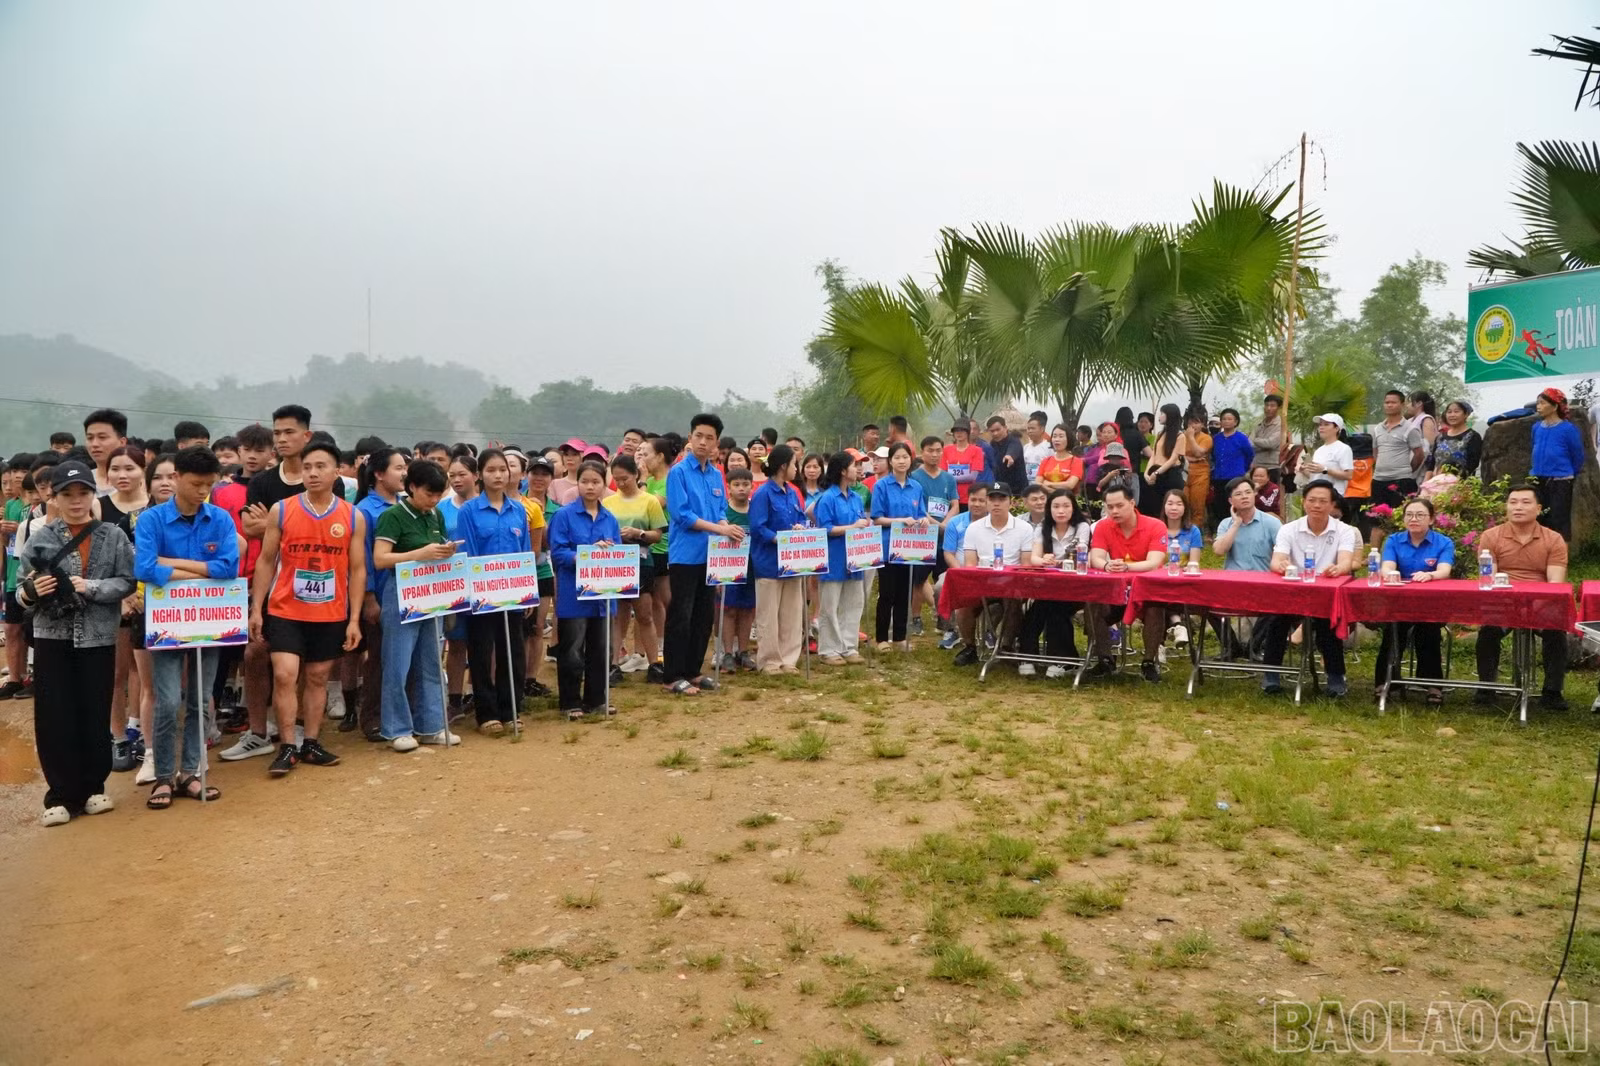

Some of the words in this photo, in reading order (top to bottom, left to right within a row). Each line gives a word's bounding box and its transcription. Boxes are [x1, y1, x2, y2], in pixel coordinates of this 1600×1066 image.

[1556, 297, 1597, 351] TOÀN
[288, 544, 310, 553] STAR
[312, 544, 344, 555] SPORTS
[802, 548, 826, 558] RUNNERS
[605, 566, 636, 578] RUNNERS
[305, 580, 326, 594] 441
[510, 576, 535, 588] RUNNERS
[204, 587, 225, 597] VĐV
[402, 584, 431, 601] VPBANK
[432, 578, 465, 595] RUNNERS
[152, 606, 181, 623] NGHĨA
[184, 605, 197, 622] ĐÔ
[200, 606, 242, 621] RUNNERS
